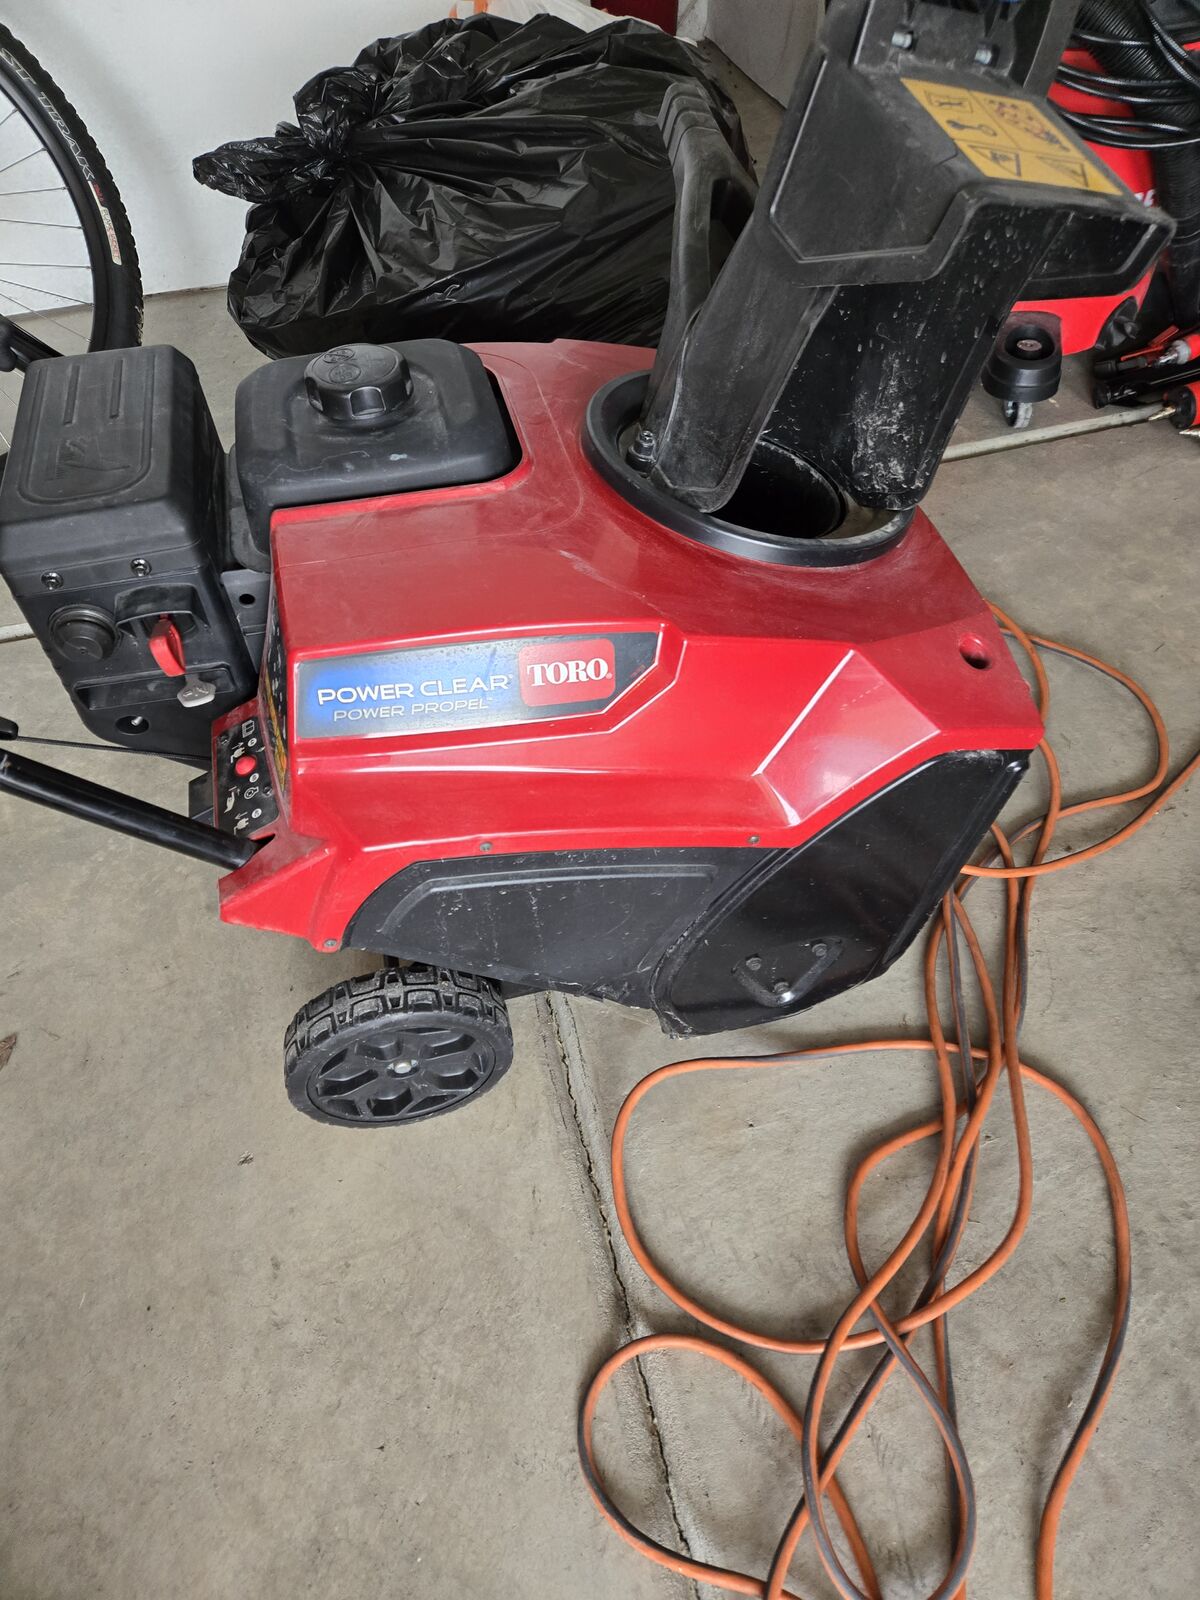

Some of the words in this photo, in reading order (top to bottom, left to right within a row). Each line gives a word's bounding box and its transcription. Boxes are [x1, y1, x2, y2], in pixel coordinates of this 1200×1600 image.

[38, 92, 95, 180] TRAK
[527, 657, 609, 686] TORO
[317, 683, 415, 705] POWER
[419, 674, 509, 697] CLEAR
[333, 705, 405, 722] POWER
[411, 698, 489, 715] PROPEL
